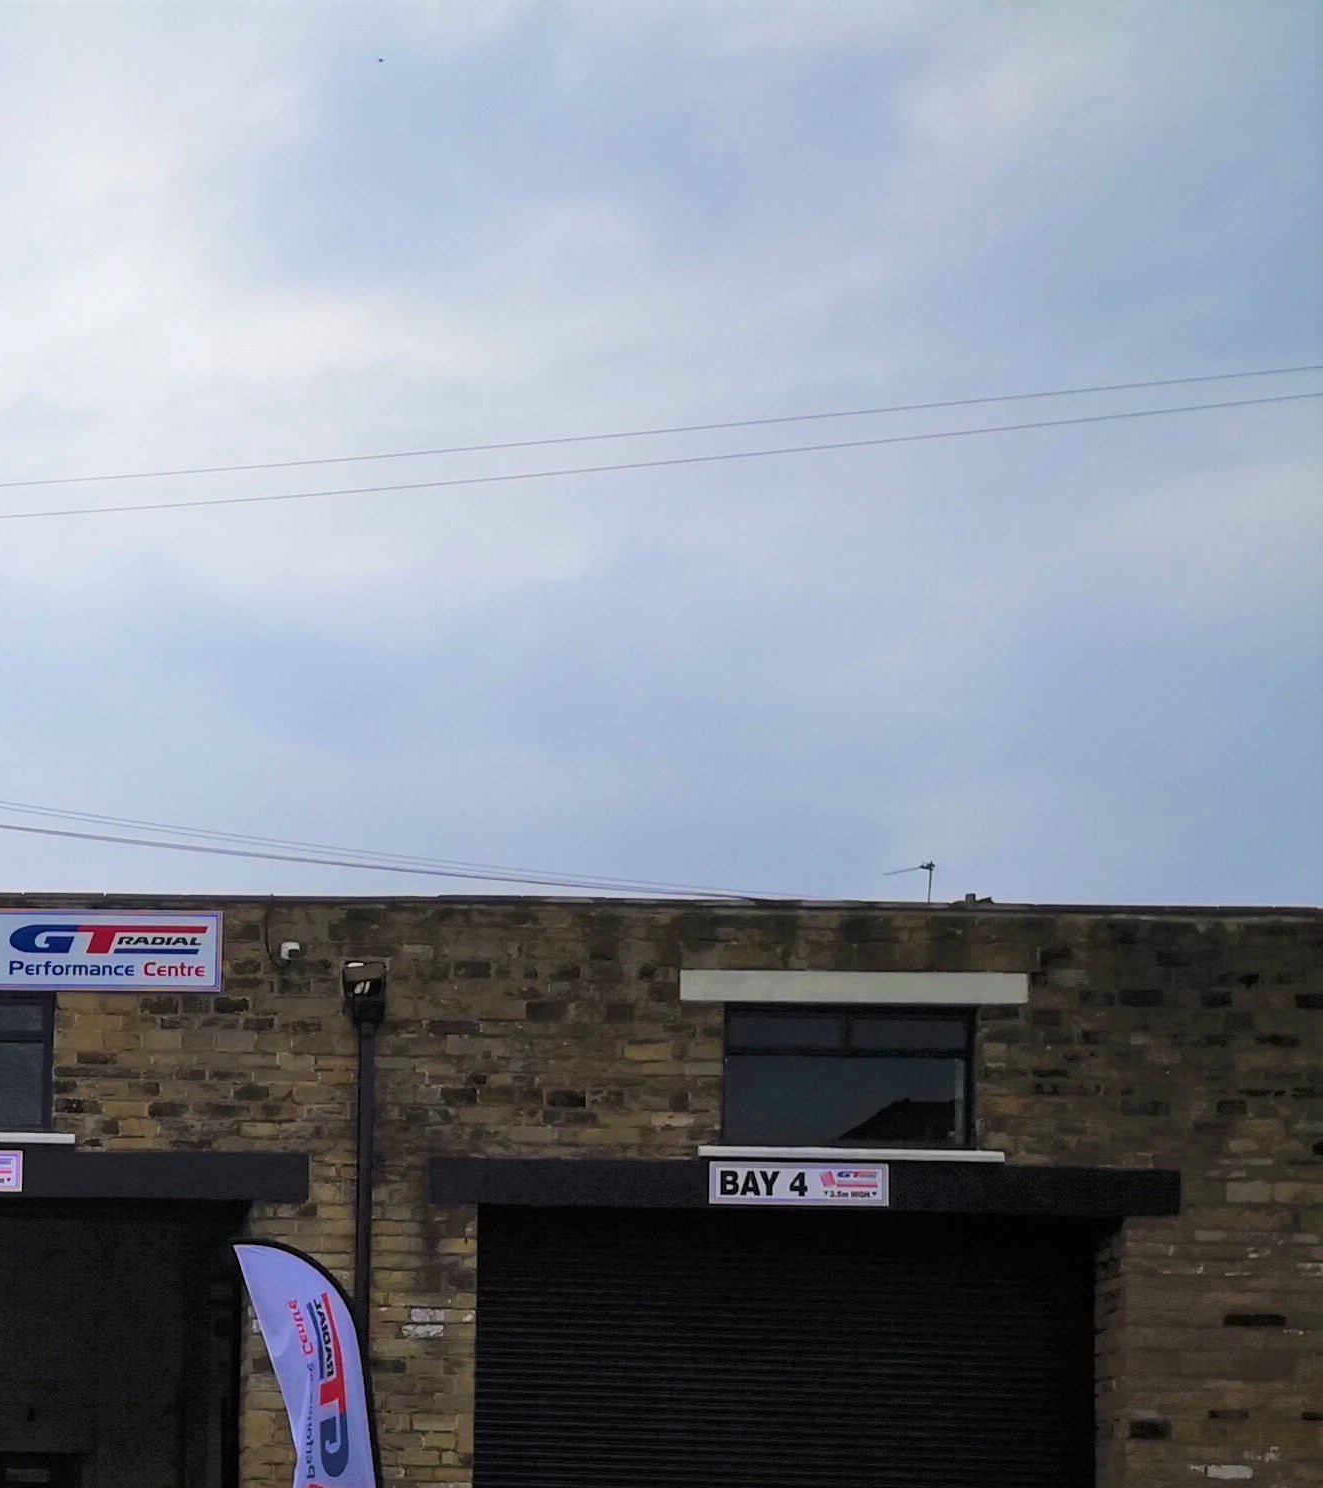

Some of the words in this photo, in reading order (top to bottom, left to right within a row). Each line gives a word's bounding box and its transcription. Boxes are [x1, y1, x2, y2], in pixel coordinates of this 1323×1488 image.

[9, 924, 118, 954] GT
[117, 936, 202, 946] RADIAL
[9, 960, 135, 976] Performance
[143, 961, 205, 977] Centre
[720, 1170, 780, 1196] BAY
[789, 1172, 808, 1197] 4
